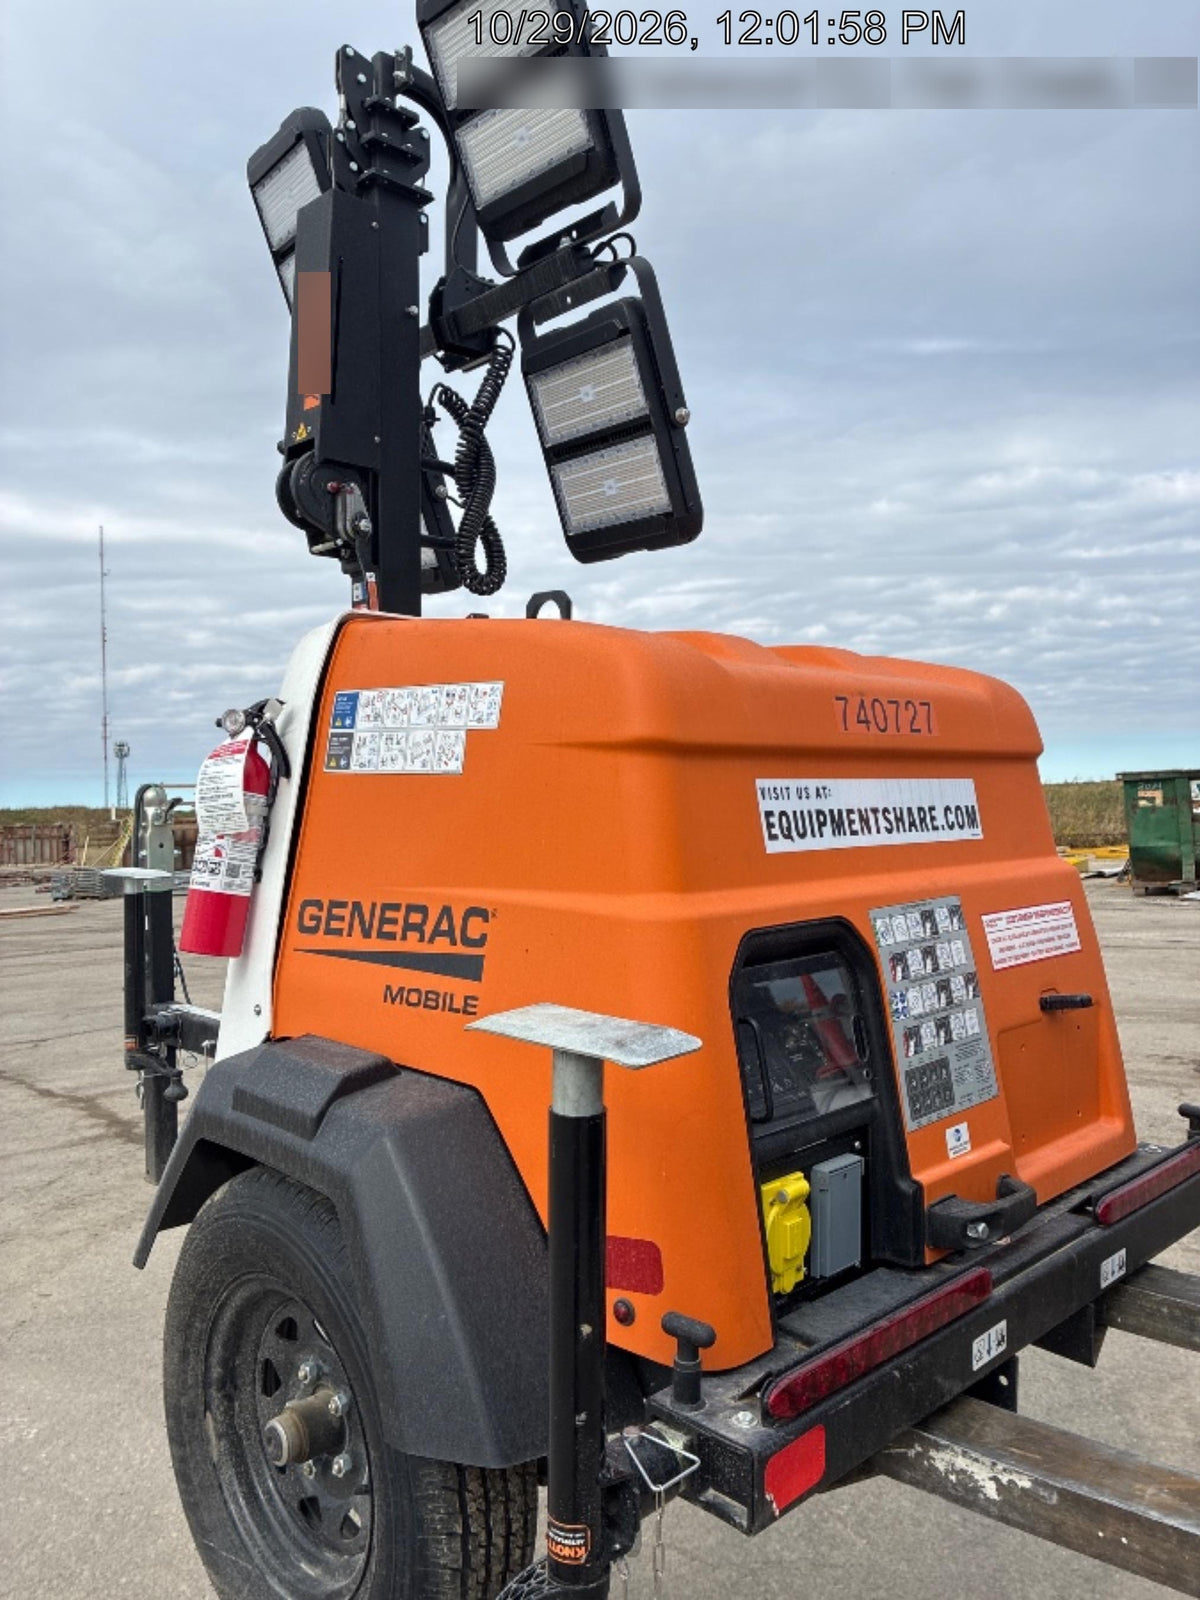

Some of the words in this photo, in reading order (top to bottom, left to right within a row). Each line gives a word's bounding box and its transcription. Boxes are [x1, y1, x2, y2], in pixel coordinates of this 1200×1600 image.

[835, 696, 932, 734] 740727
[759, 787, 790, 800] VISIT
[796, 787, 810, 799] US
[815, 786, 831, 799] AT:
[764, 805, 979, 842] EQUIPMENTSHARE.COM
[297, 899, 490, 948] GENERAC
[383, 984, 480, 1016] MOBILE
